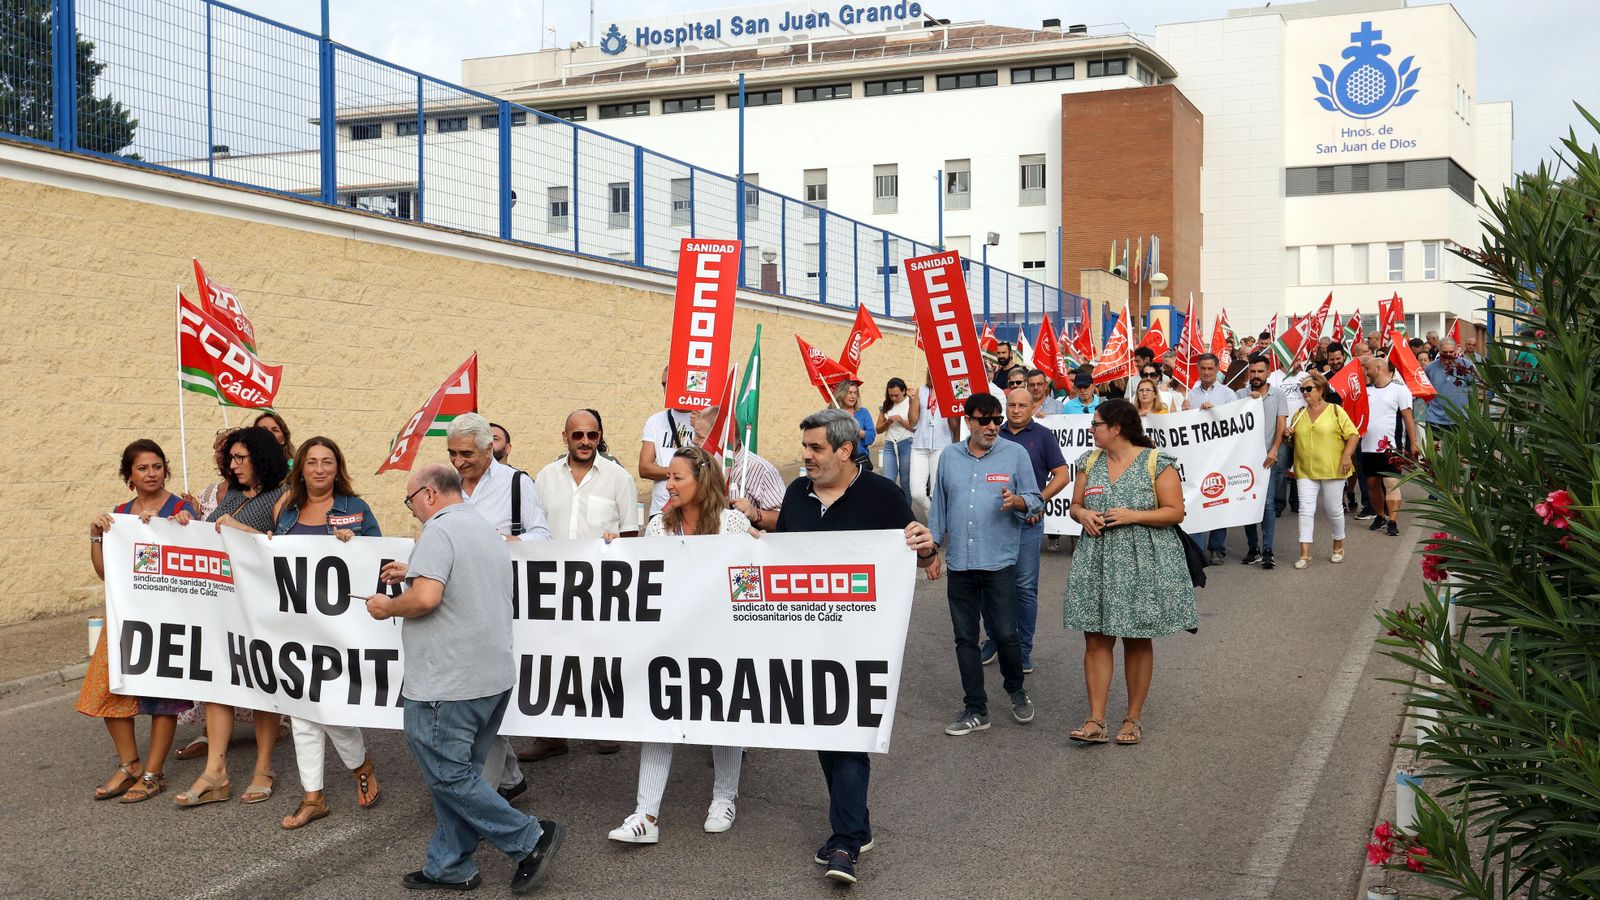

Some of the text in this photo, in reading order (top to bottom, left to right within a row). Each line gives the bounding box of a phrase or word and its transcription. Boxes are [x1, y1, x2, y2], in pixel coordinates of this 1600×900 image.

[635, 2, 922, 47] Hospital San Juan Grande
[1341, 124, 1394, 138] Hnos. de
[1316, 138, 1417, 154] San Juan de Dios
[686, 243, 735, 253] SANIDAD
[910, 256, 955, 271] SANIDAD
[687, 253, 721, 367] CCOO
[923, 267, 969, 377] CCOO
[218, 371, 269, 404] Cádiz
[678, 395, 711, 407] CÁDIZ
[1077, 429, 1093, 447] DE
[1169, 426, 1189, 447] DE
[1191, 411, 1255, 443] TRABAJO
[330, 516, 356, 525] CCOO
[167, 551, 221, 575] CCOO
[133, 574, 168, 584] sindicato
[170, 577, 178, 585] de
[179, 578, 207, 588] sanidad
[212, 582, 235, 592] sectores
[133, 582, 218, 597] sociosanitarios de Cádiz
[273, 555, 351, 617] NO
[512, 560, 665, 622] IERRE
[770, 573, 849, 594] CCOO
[732, 602, 876, 613] sindicato de sanidad y sectores
[733, 611, 843, 622] sociosanitarios de Cádiz
[120, 619, 888, 728] DEL HOSPIT UAN GRANDE
